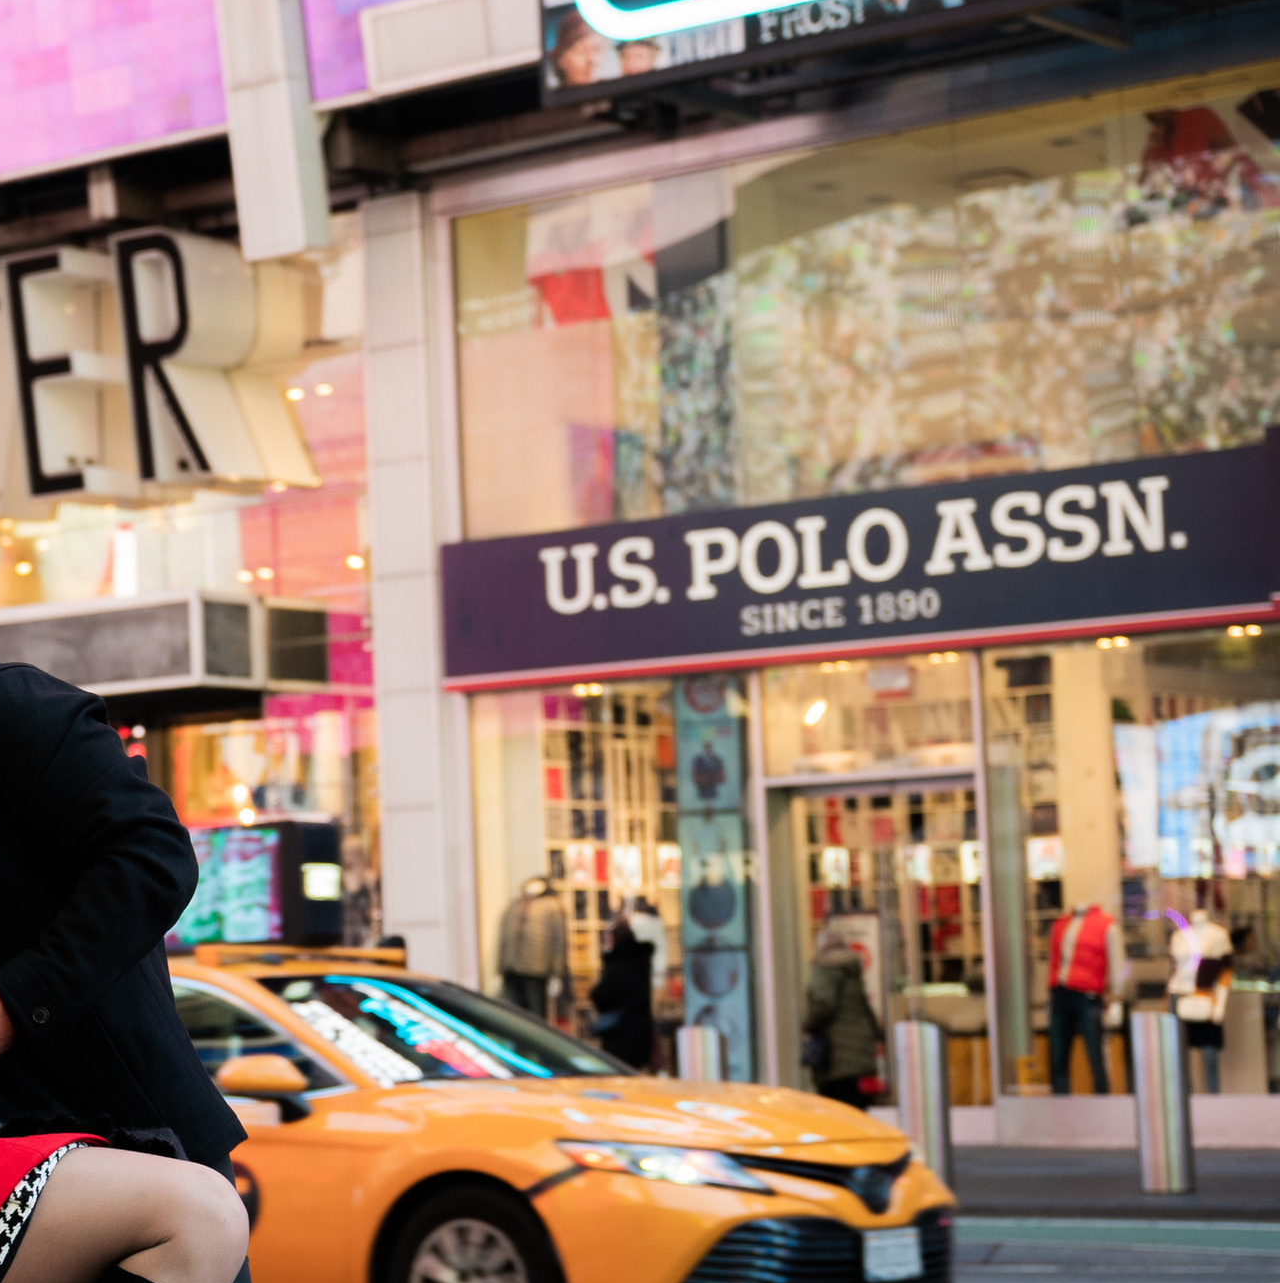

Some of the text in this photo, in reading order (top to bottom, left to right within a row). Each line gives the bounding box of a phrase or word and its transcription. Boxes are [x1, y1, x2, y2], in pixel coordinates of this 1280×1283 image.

[538, 475, 1188, 615] U.S. POLO ASSN.
[740, 588, 941, 636] SINCE 1890
